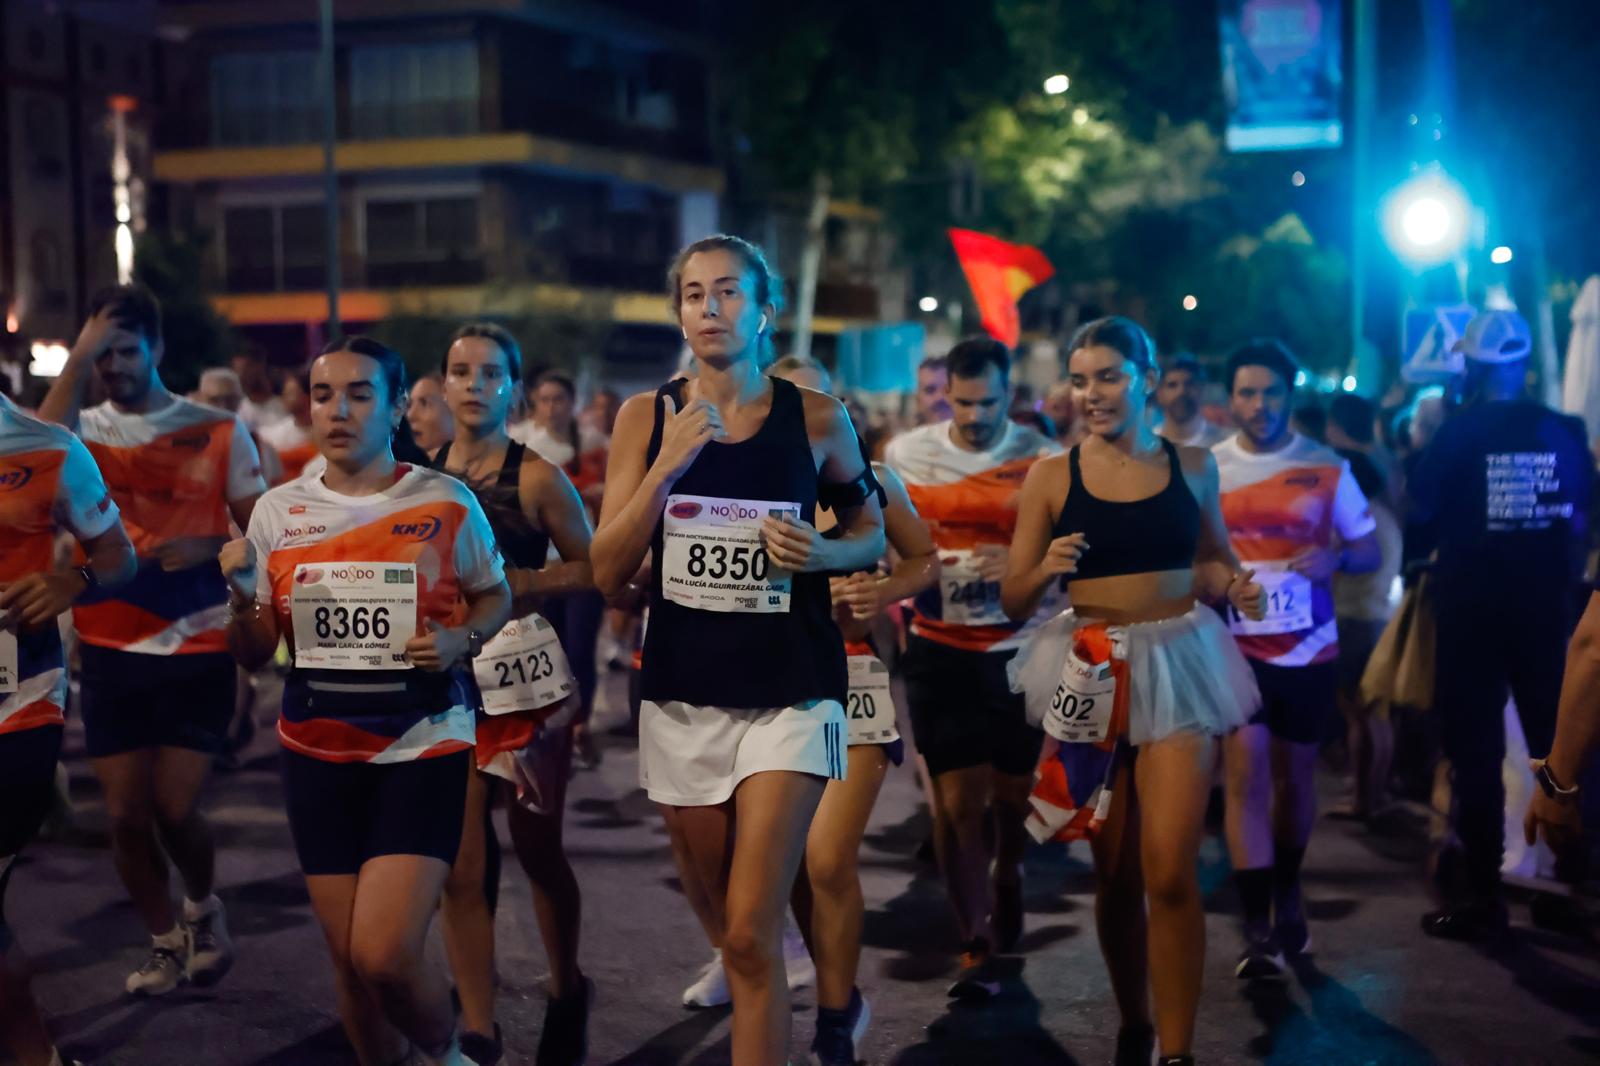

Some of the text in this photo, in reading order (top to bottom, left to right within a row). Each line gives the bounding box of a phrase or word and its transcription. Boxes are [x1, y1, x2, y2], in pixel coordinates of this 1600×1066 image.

[687, 543, 769, 581] 8350
[669, 576, 684, 585] ANA
[685, 578, 707, 588] LUCÍA
[708, 582, 764, 592] AGUIRREZÁBAL
[315, 607, 390, 639] 8366
[338, 641, 363, 649] GARCÍA
[365, 641, 390, 649] GÓMEZ
[495, 650, 553, 688] 2123
[849, 693, 876, 719] 20
[1053, 684, 1095, 721] 502
